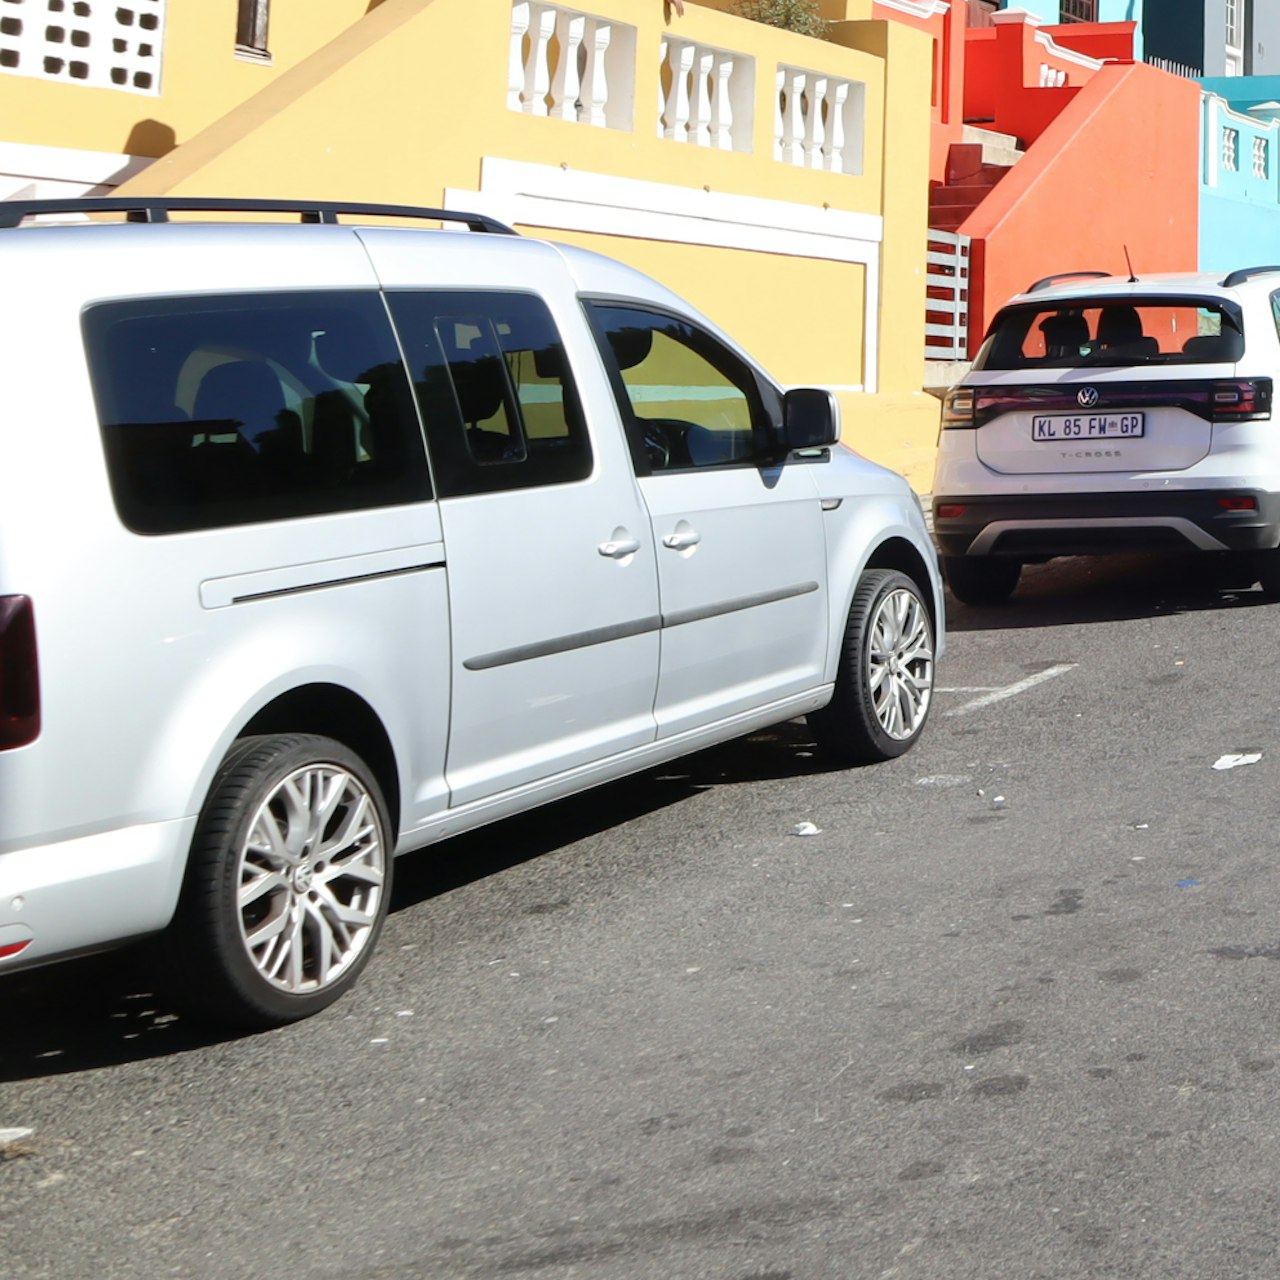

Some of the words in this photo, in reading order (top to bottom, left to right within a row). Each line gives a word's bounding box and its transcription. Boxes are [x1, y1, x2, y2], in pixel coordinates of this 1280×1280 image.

[1038, 419, 1056, 437] KL
[1063, 418, 1081, 436] 85
[1088, 417, 1107, 435] FW
[1120, 416, 1138, 434] GP
